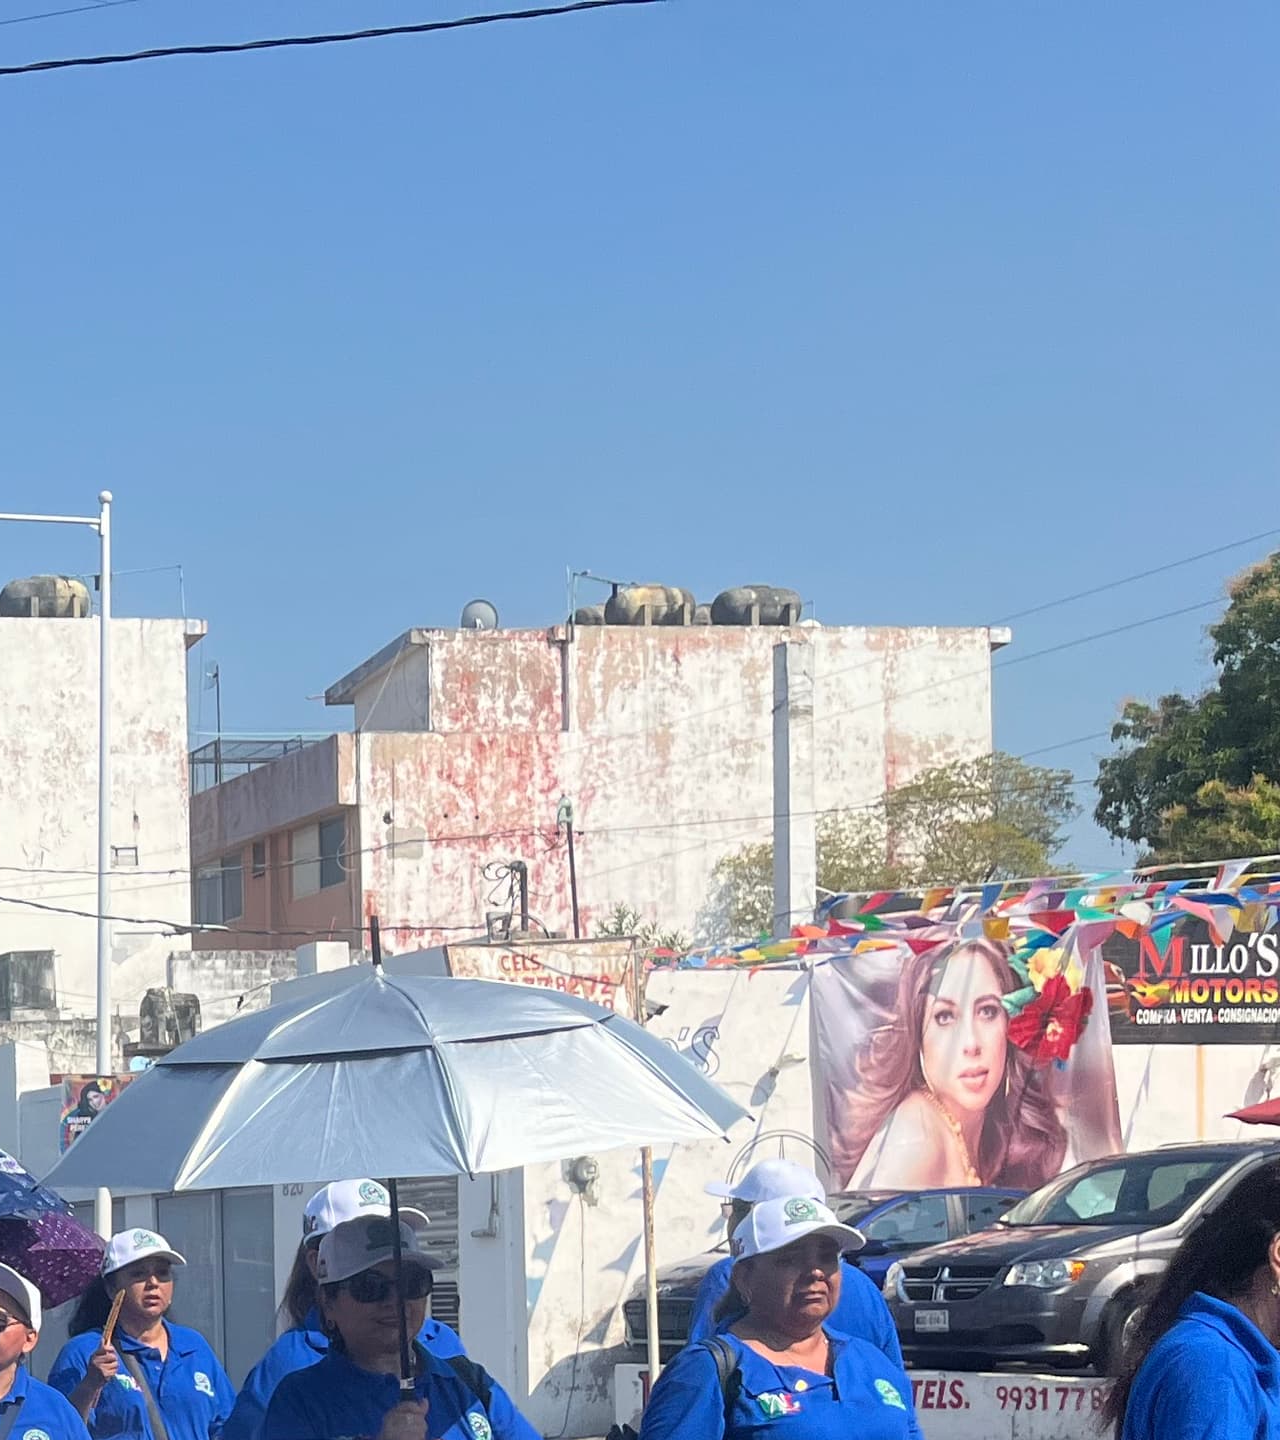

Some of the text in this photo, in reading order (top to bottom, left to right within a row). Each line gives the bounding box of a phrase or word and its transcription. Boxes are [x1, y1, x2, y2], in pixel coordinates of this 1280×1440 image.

[1169, 977, 1279, 1004] MOTORS
[1180, 1008, 1214, 1025] VENTA
[912, 1379, 971, 1410] TELS.
